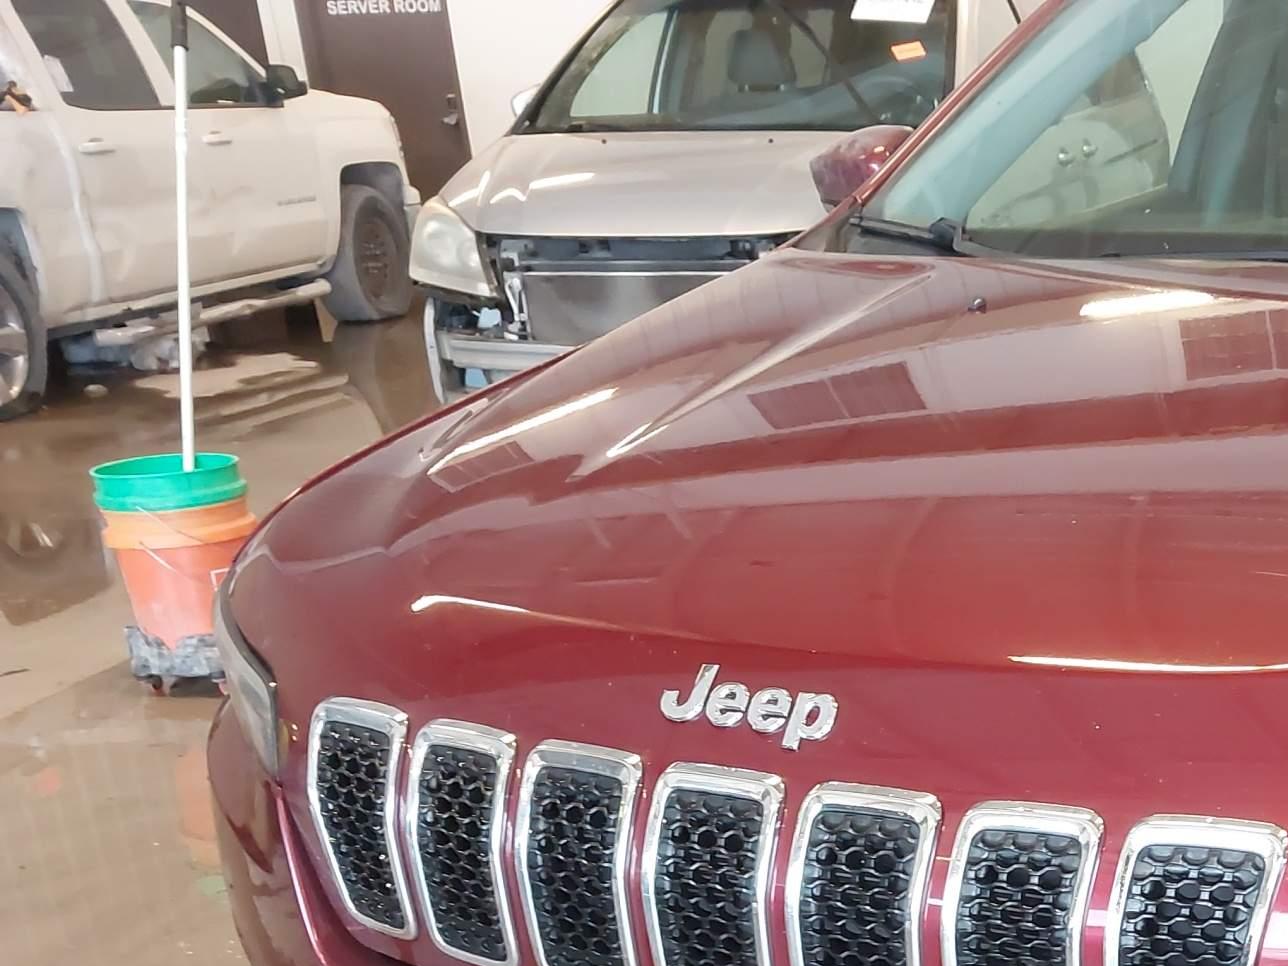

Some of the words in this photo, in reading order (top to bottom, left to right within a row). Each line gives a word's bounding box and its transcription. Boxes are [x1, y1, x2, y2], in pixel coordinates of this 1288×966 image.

[326, 0, 391, 15] SERVER
[393, 0, 441, 13] ROOM
[660, 663, 839, 752] Jeep
